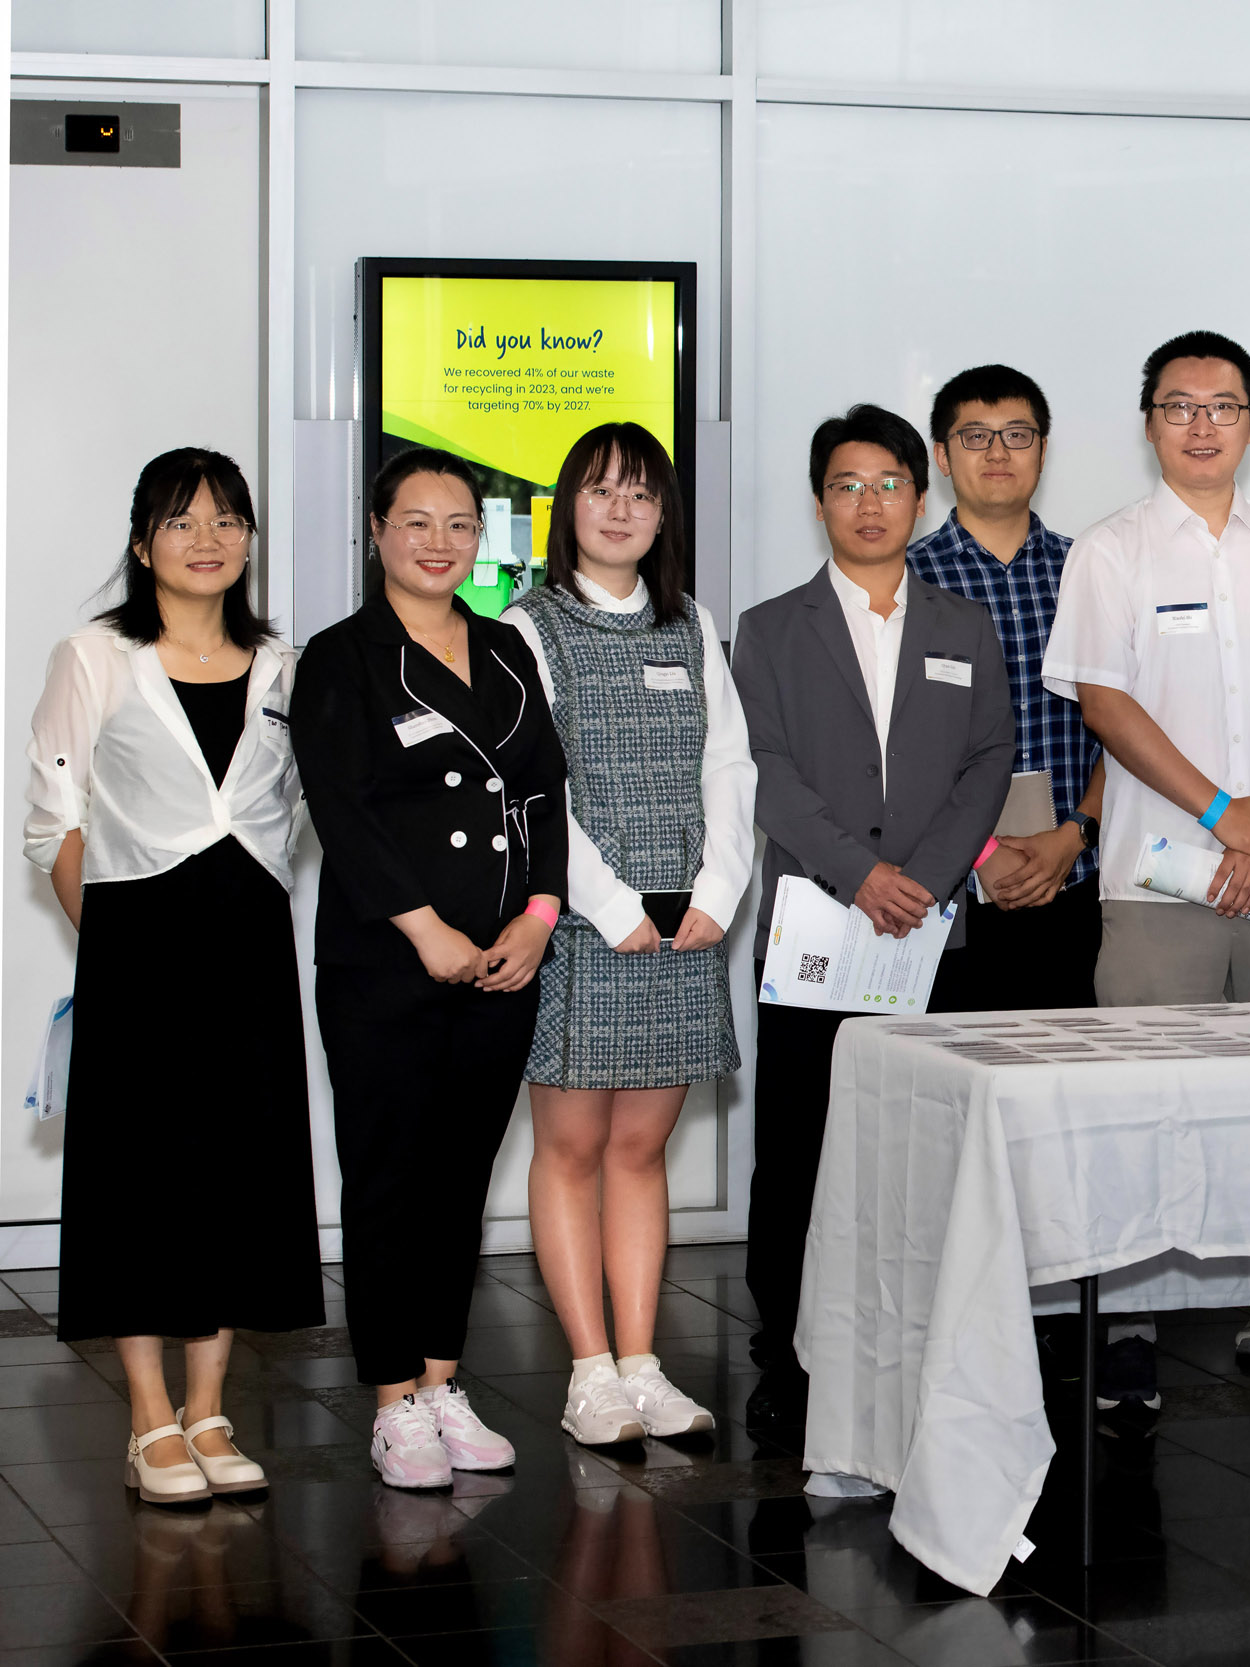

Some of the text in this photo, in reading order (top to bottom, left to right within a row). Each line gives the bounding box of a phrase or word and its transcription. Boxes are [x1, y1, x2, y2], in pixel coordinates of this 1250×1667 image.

[457, 326, 602, 359] Did you know?
[444, 368, 615, 379] We recovered 41% of our waste
[444, 384, 459, 394] for
[462, 384, 512, 396] recycling
[516, 384, 526, 394] in
[529, 384, 558, 396] 2023,
[561, 385, 583, 395] and
[468, 400, 591, 413] targeting 70% by 2027.
